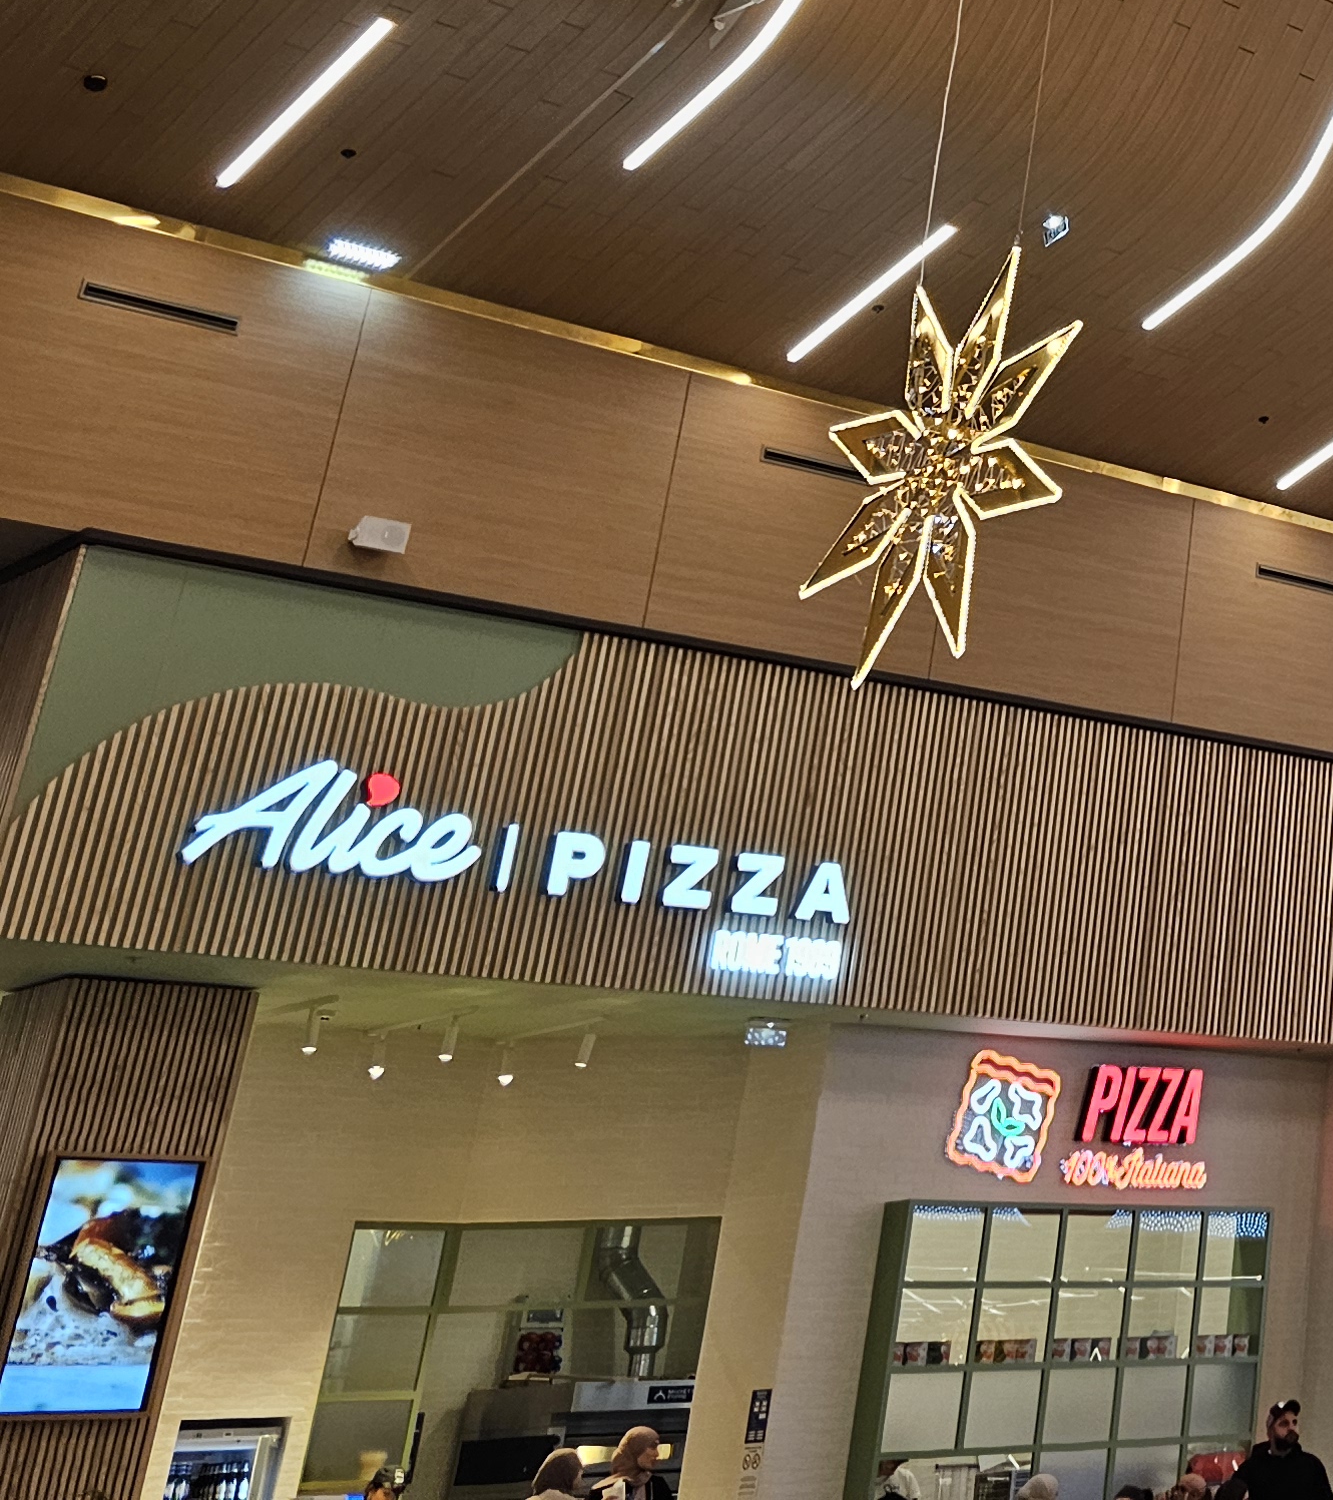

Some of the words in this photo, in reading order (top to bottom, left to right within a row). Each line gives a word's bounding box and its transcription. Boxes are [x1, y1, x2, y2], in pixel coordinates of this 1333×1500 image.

[180, 759, 483, 884] Alice
[546, 831, 850, 924] PIZZA
[1081, 1064, 1205, 1145] PIZZA
[1115, 1147, 1208, 1191] Italiana
